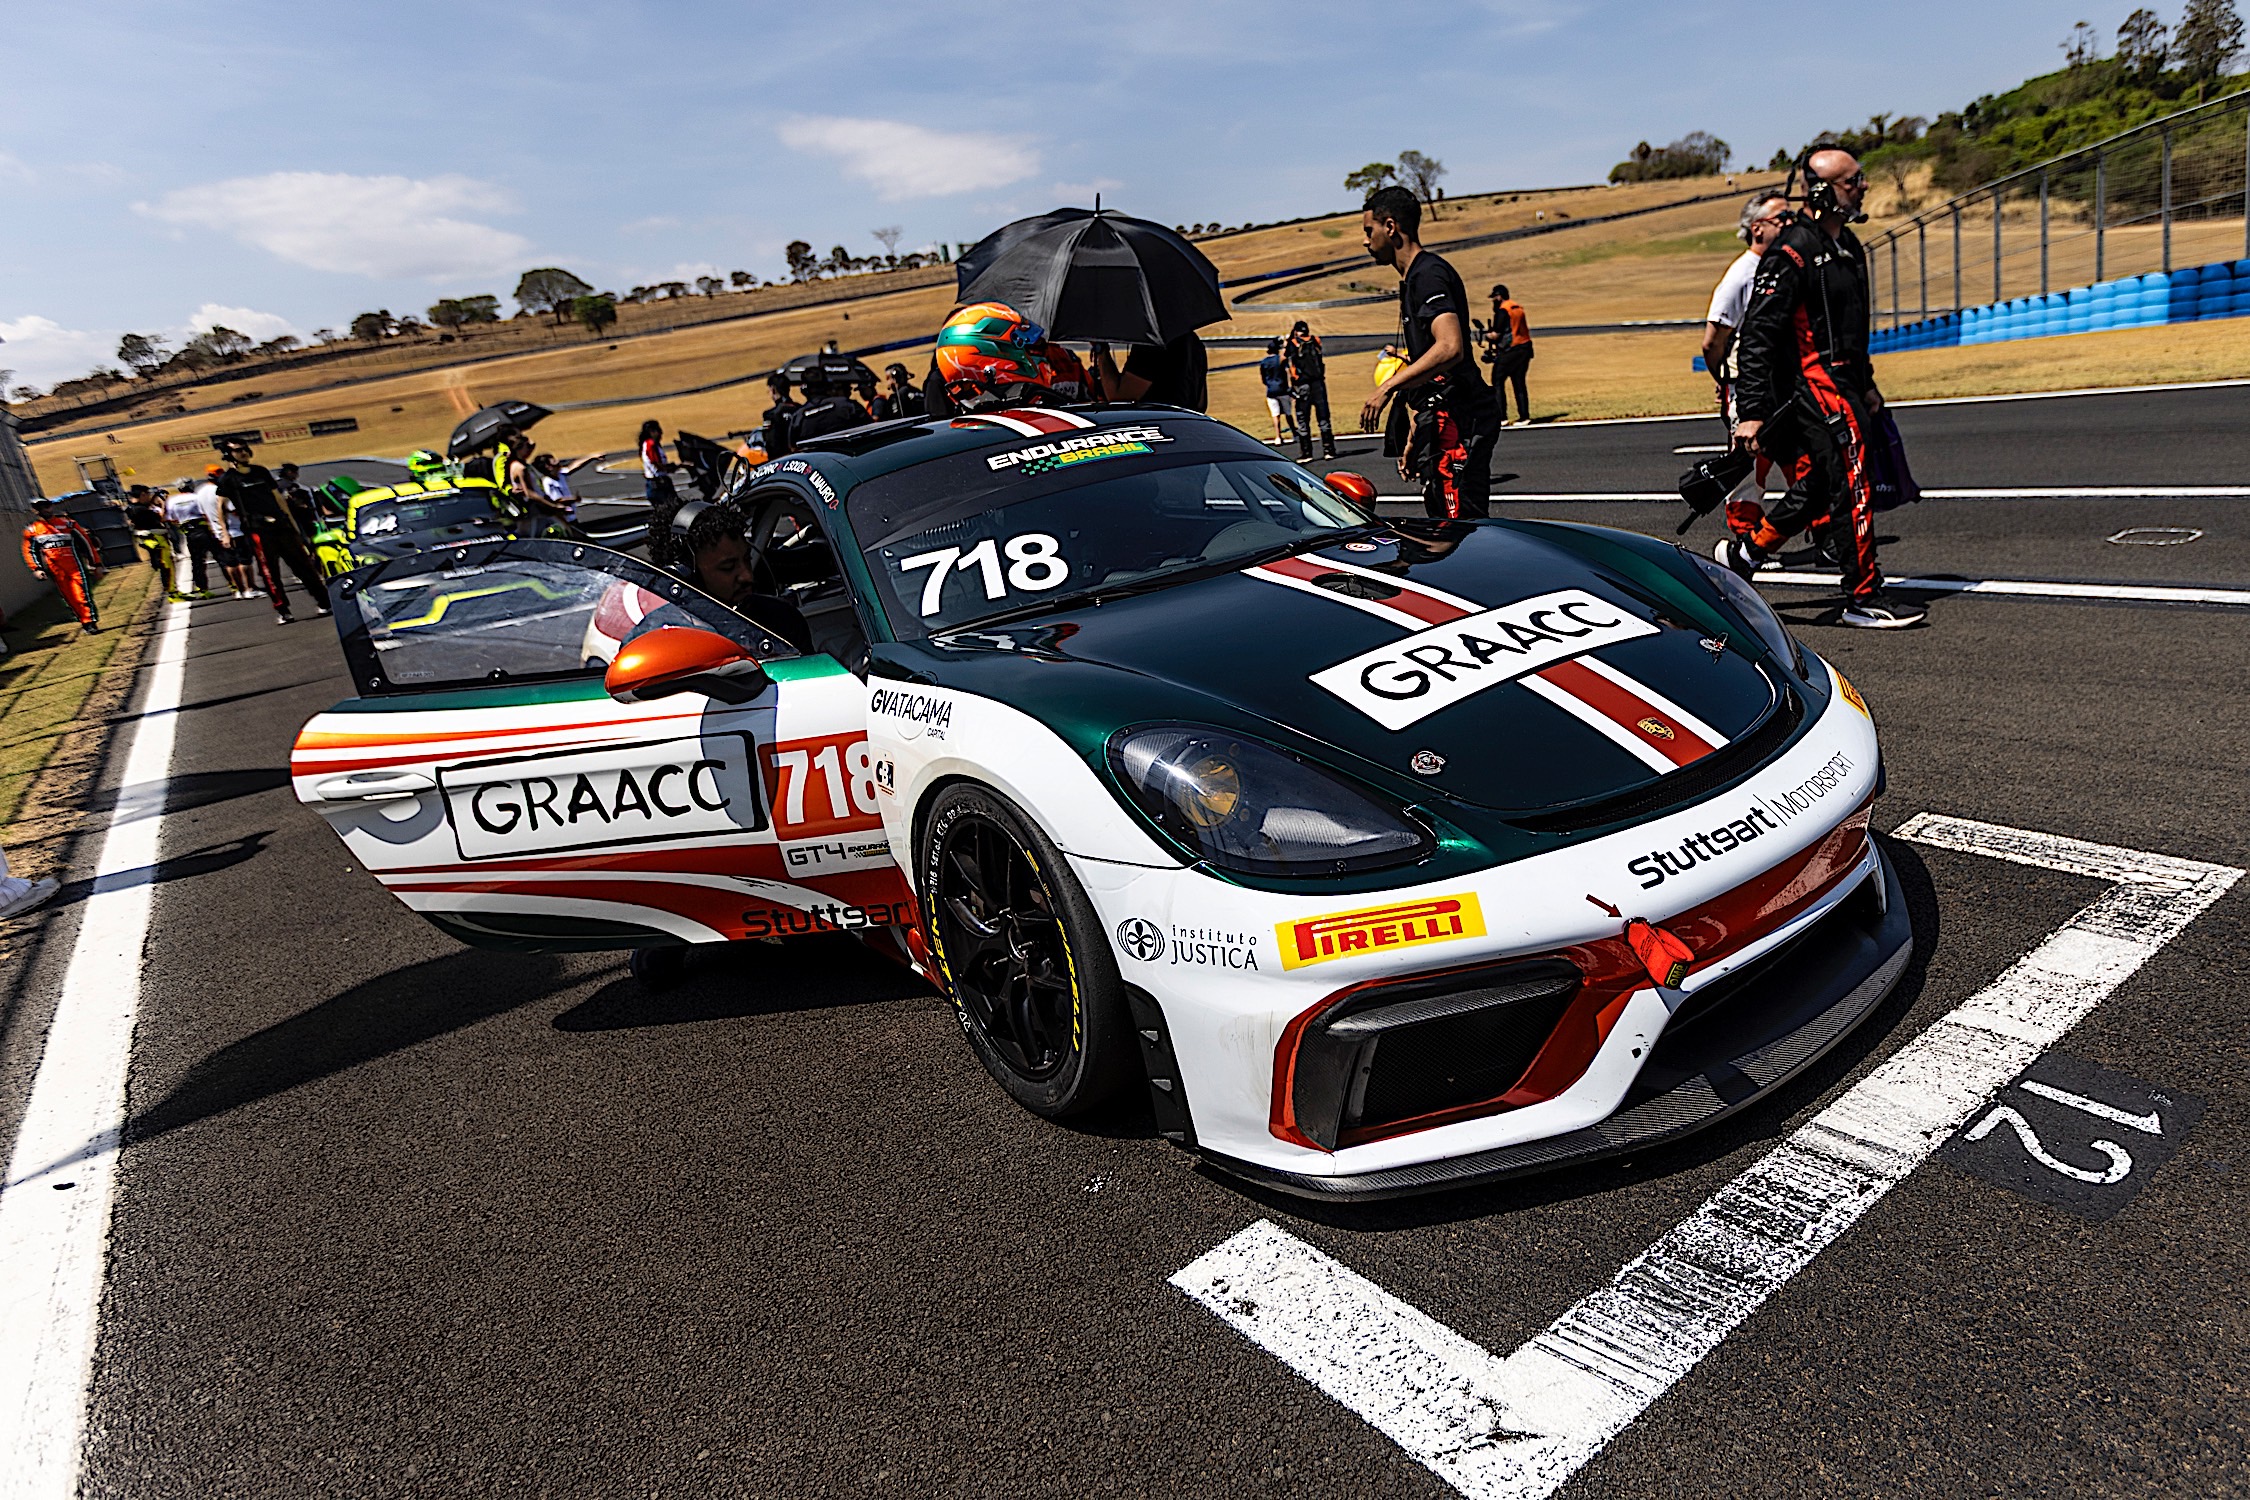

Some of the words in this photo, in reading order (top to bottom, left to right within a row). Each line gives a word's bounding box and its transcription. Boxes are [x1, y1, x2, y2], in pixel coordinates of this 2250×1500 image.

[987, 428, 1167, 471] ENDURANCE
[1058, 442, 1145, 464] BRASIL
[359, 514, 399, 535] 44
[900, 532, 1069, 617] 718
[1360, 601, 1621, 701] GRAACC
[471, 758, 731, 835] GRAACC
[769, 740, 882, 825] 718
[1769, 750, 1856, 821] MOTORSPORT
[786, 842, 848, 867] GT4
[1627, 806, 1778, 890] Stuttgart
[1172, 924, 1257, 946] instituto
[1293, 900, 1465, 961] PIRELLI
[1669, 964, 1685, 987] OMP
[1963, 1077, 2165, 1185] 12
